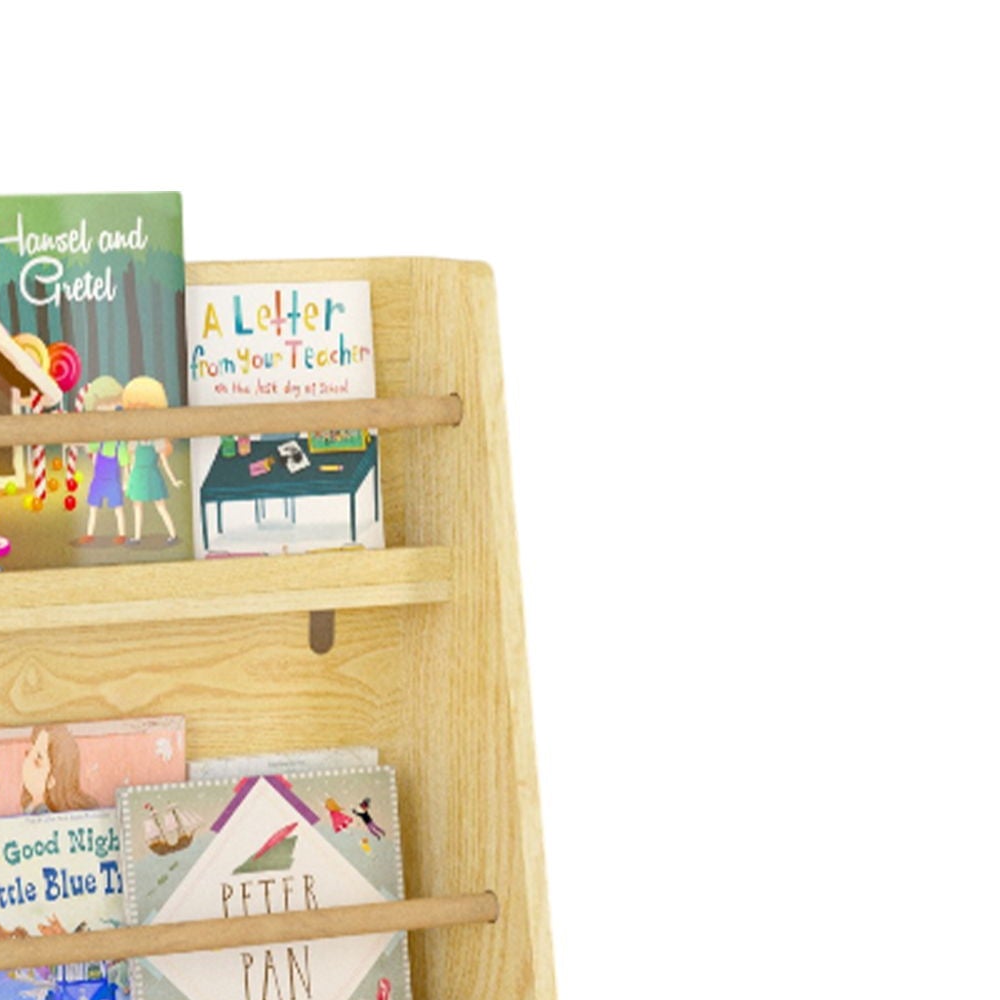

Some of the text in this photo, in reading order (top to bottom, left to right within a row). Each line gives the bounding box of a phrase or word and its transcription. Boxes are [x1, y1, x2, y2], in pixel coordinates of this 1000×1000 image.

[99, 216, 149, 250] and
[19, 256, 118, 306] Gretel
[202, 290, 346, 339] A Letter
[190, 333, 371, 381] from your Teacher
[3, 827, 121, 865] Good Nigh
[42, 866, 97, 901] Blue
